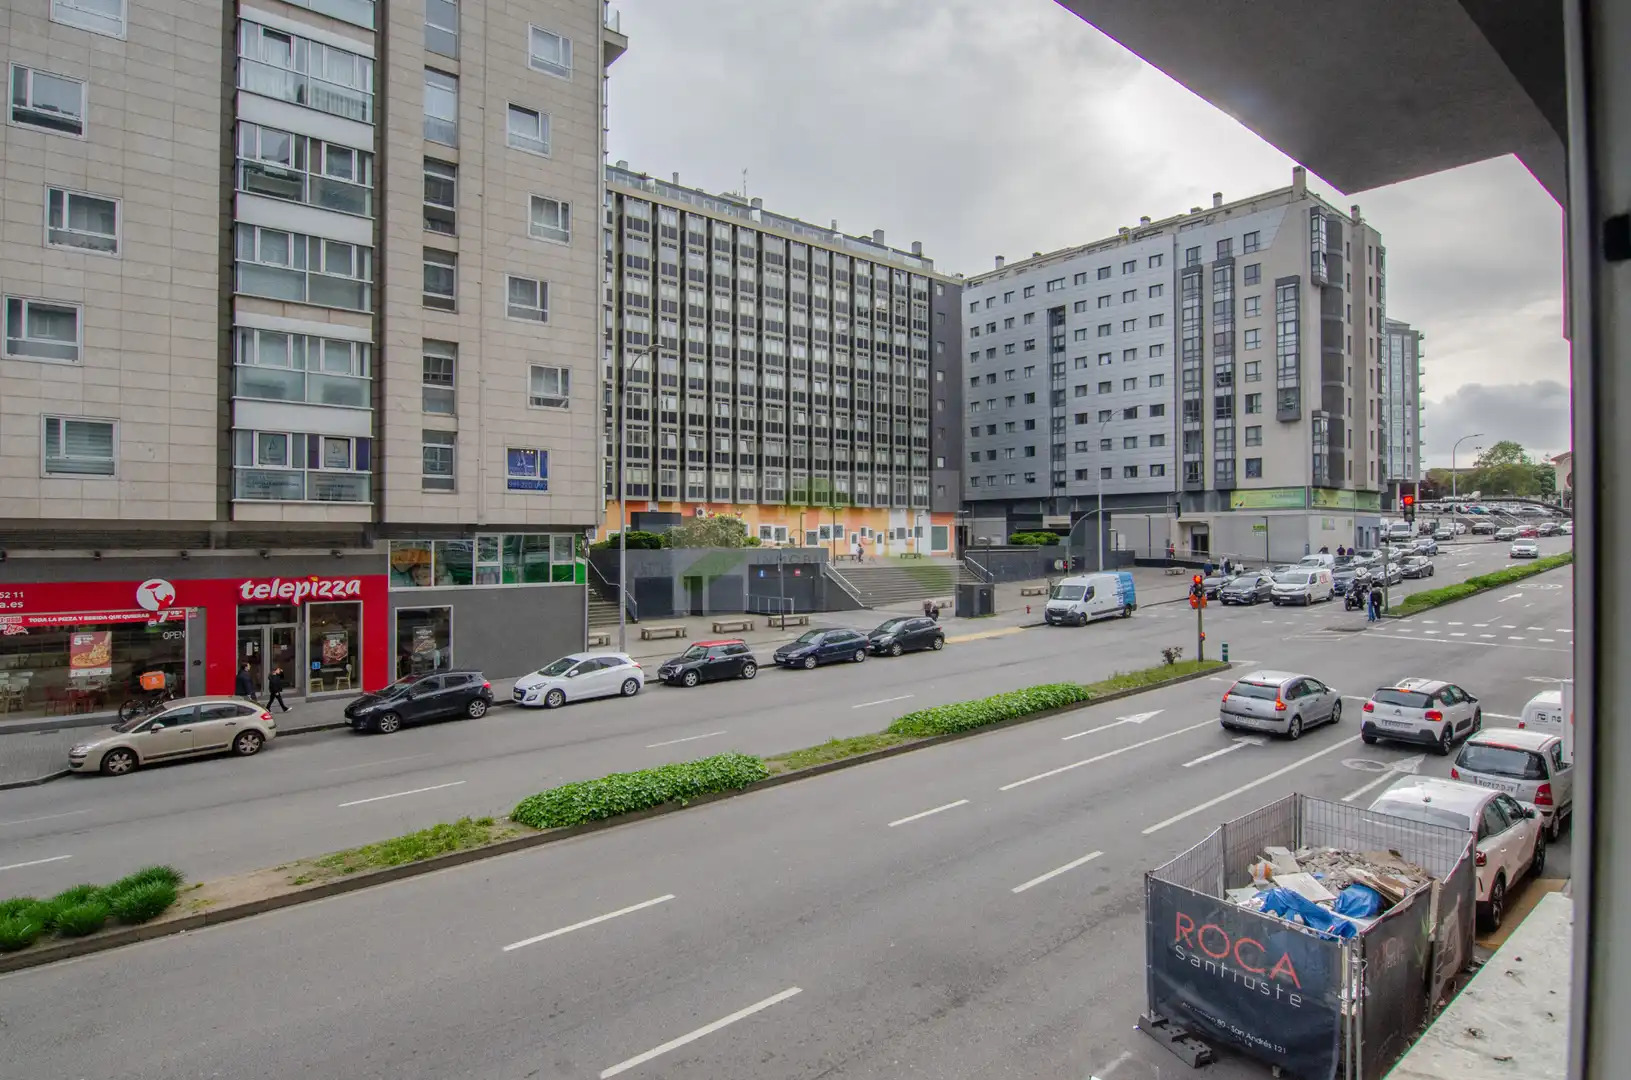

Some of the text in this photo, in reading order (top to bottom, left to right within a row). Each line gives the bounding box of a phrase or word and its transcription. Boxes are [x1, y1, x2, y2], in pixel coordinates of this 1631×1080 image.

[240, 576, 361, 605] telepizza
[163, 631, 185, 640] OPEN
[1176, 912, 1302, 990] ROCA
[1175, 945, 1302, 1008] Santiuste
[1231, 1025, 1245, 1037] San
